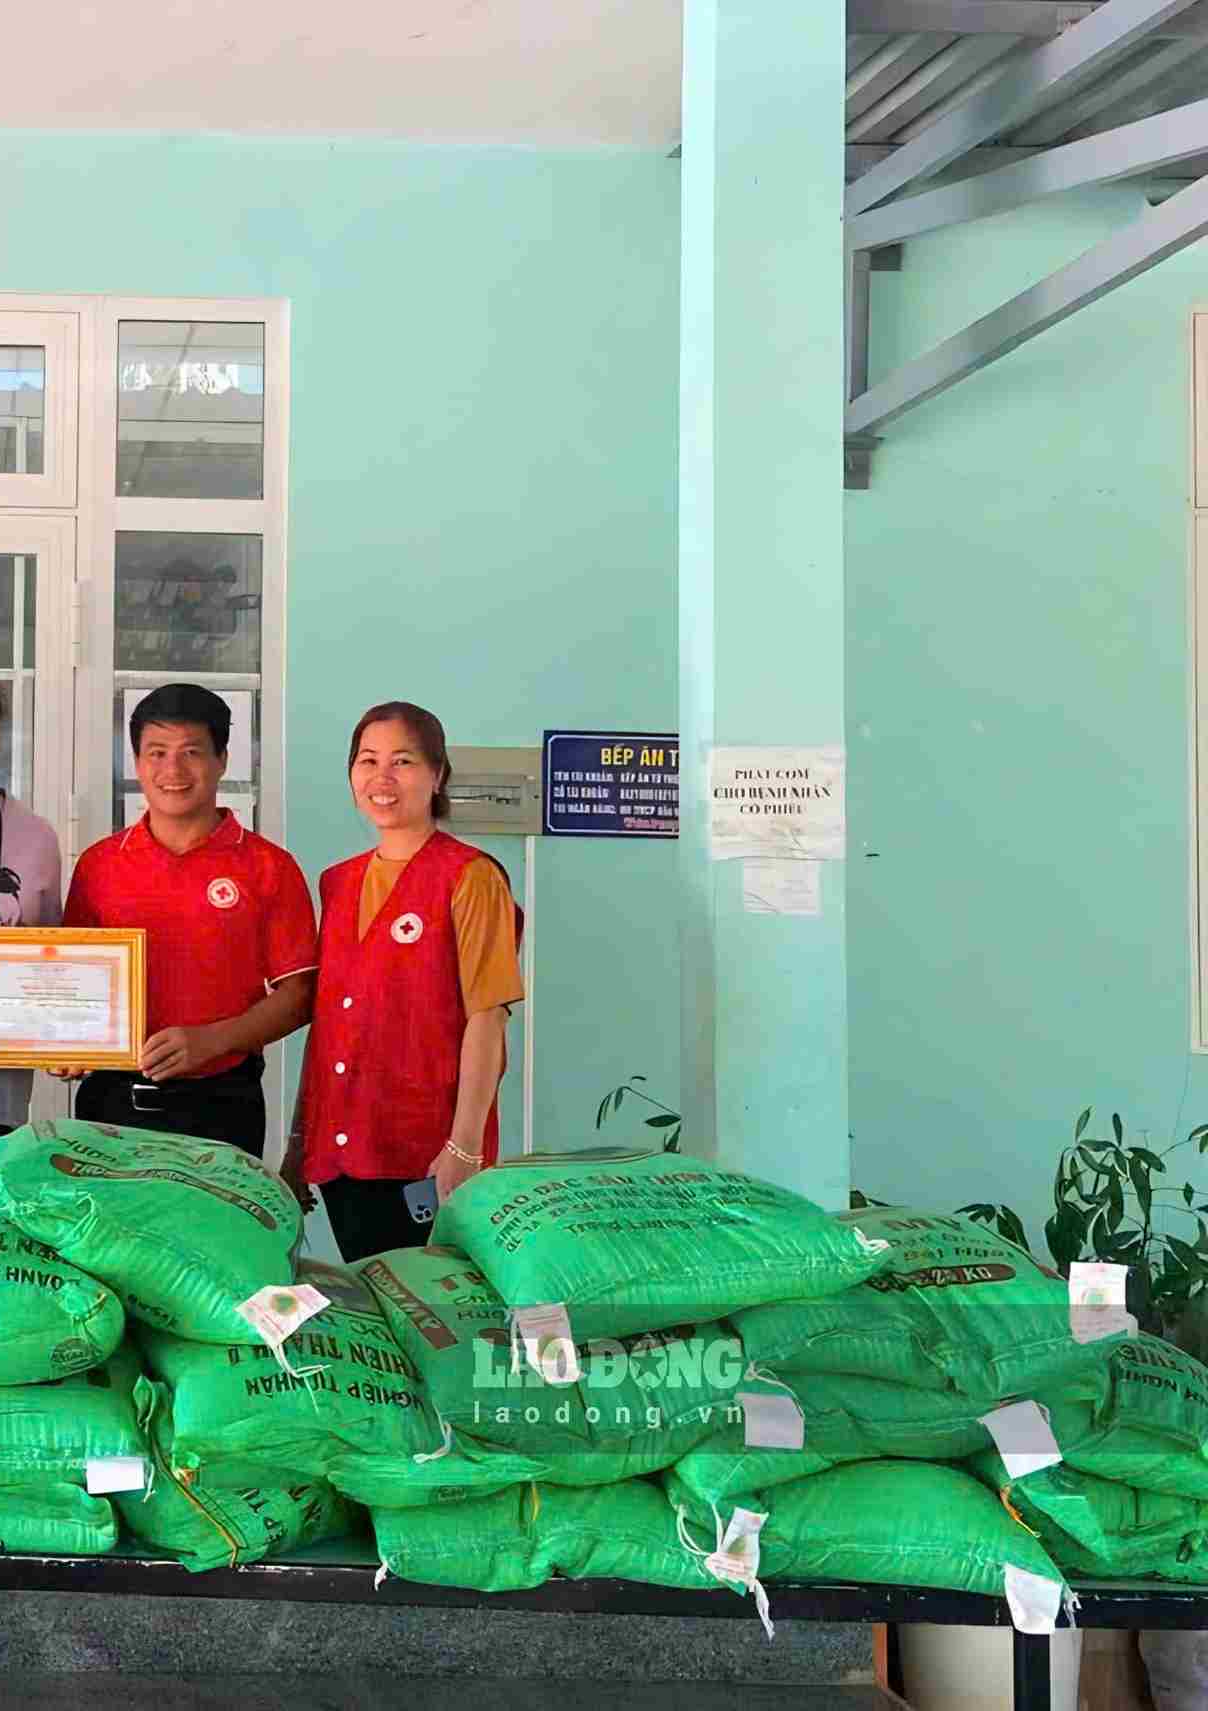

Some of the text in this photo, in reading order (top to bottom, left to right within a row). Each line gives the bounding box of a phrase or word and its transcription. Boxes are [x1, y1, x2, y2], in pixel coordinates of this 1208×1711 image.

[600, 743, 634, 766] BẾP
[639, 745, 665, 767] ĂN
[7, 1266, 79, 1291] OANH
